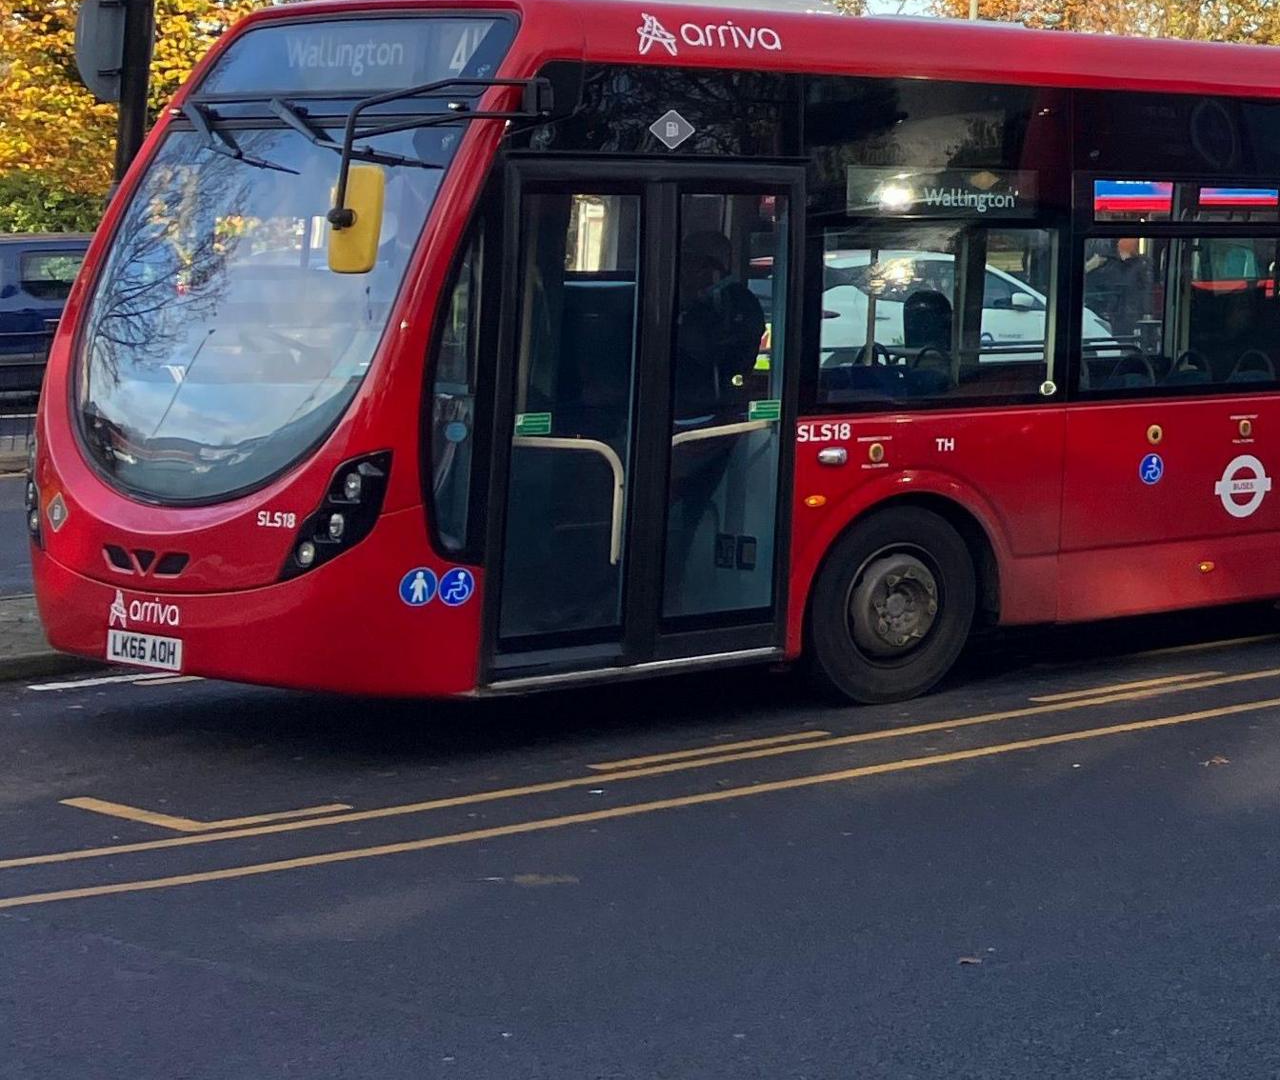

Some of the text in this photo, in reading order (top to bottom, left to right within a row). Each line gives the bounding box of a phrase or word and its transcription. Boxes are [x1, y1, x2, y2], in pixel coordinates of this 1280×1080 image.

[680, 21, 782, 51] arriva
[286, 33, 404, 77] Wallington
[924, 186, 1015, 212] Wallington
[797, 423, 851, 442] SLS18
[936, 437, 955, 452] TH
[1233, 482, 1254, 491] BUSES
[257, 510, 296, 528] SLS18
[129, 597, 180, 626] arriva
[112, 633, 177, 666] LK66 AOH
